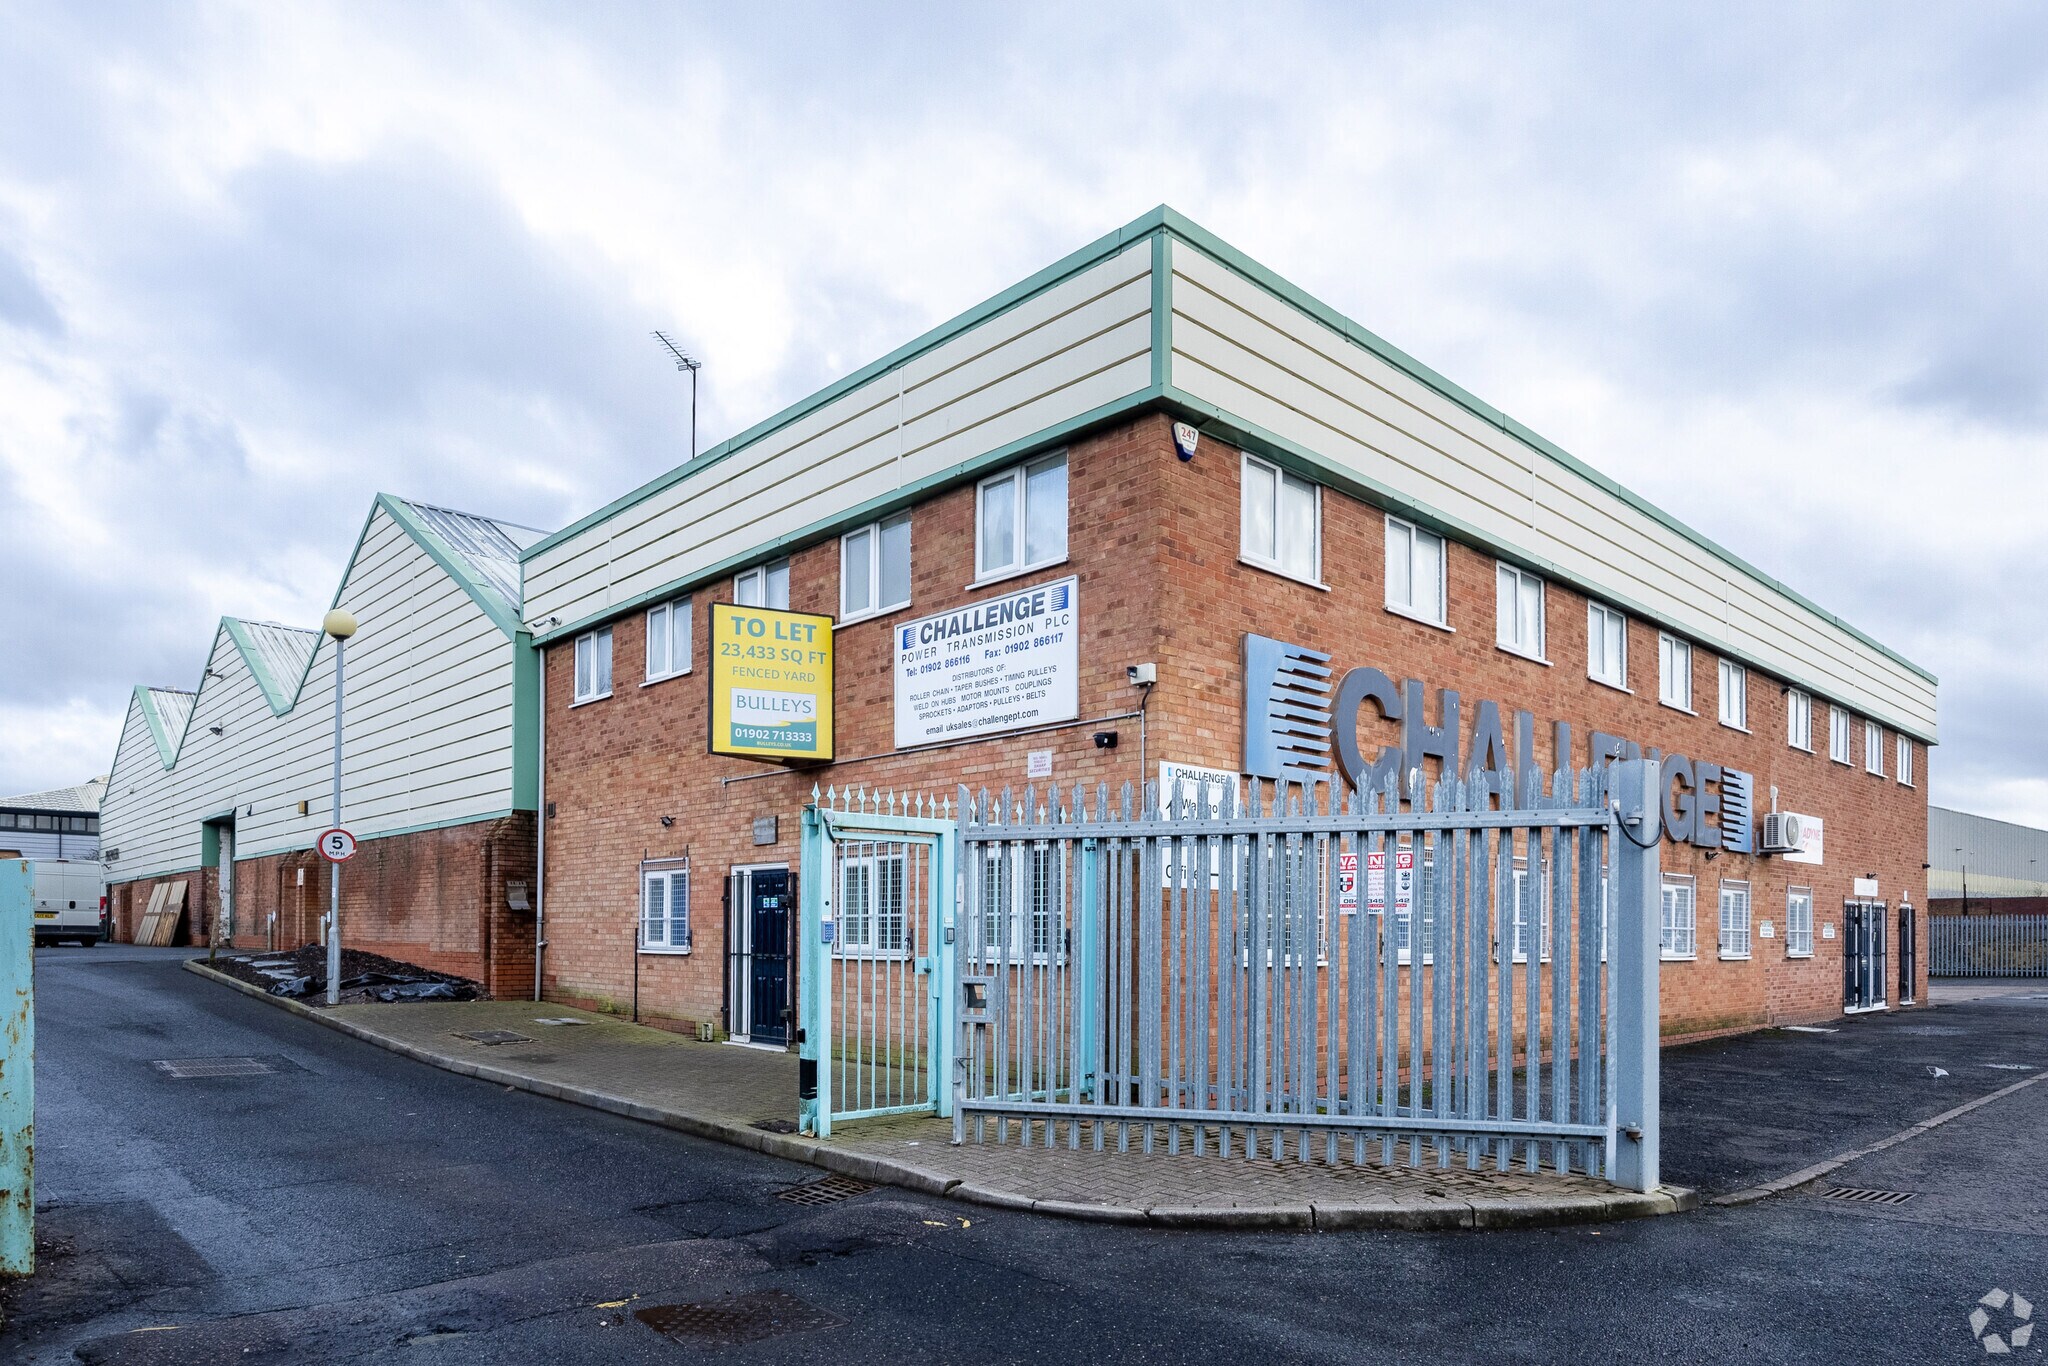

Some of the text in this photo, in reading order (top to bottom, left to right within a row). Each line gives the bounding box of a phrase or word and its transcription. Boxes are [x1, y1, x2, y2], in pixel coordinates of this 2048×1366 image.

[731, 616, 817, 643] TO LET
[920, 591, 1046, 645] CHALLENGE
[901, 613, 1070, 664] POWER TRANSMISSION PLC
[720, 642, 827, 665] 23,433 SQ FT
[906, 632, 1064, 677] Tel: 01902 866116 Fax: 01902 866117
[732, 666, 816, 683] FENCED YARD
[909, 665, 1057, 702] ROLLER CHAIN TAPER BUSHES TIMING PULLEYS
[952, 663, 1007, 682] DISTRIBUTORS OF:
[736, 694, 812, 714] BULLEYS
[913, 677, 1053, 711] WELD ON HUBS MOTOR MOUNTS COUPLINGS
[918, 689, 1046, 721] SPROCKETS ADAPTORS PULLEYS BELTS
[734, 727, 812, 742] 01902 713333
[925, 708, 1039, 736] email uksales@challengept.com
[1331, 666, 1722, 848] CHALLEGE
[1175, 768, 1226, 785] CHALLENGE
[332, 836, 344, 850] 5
